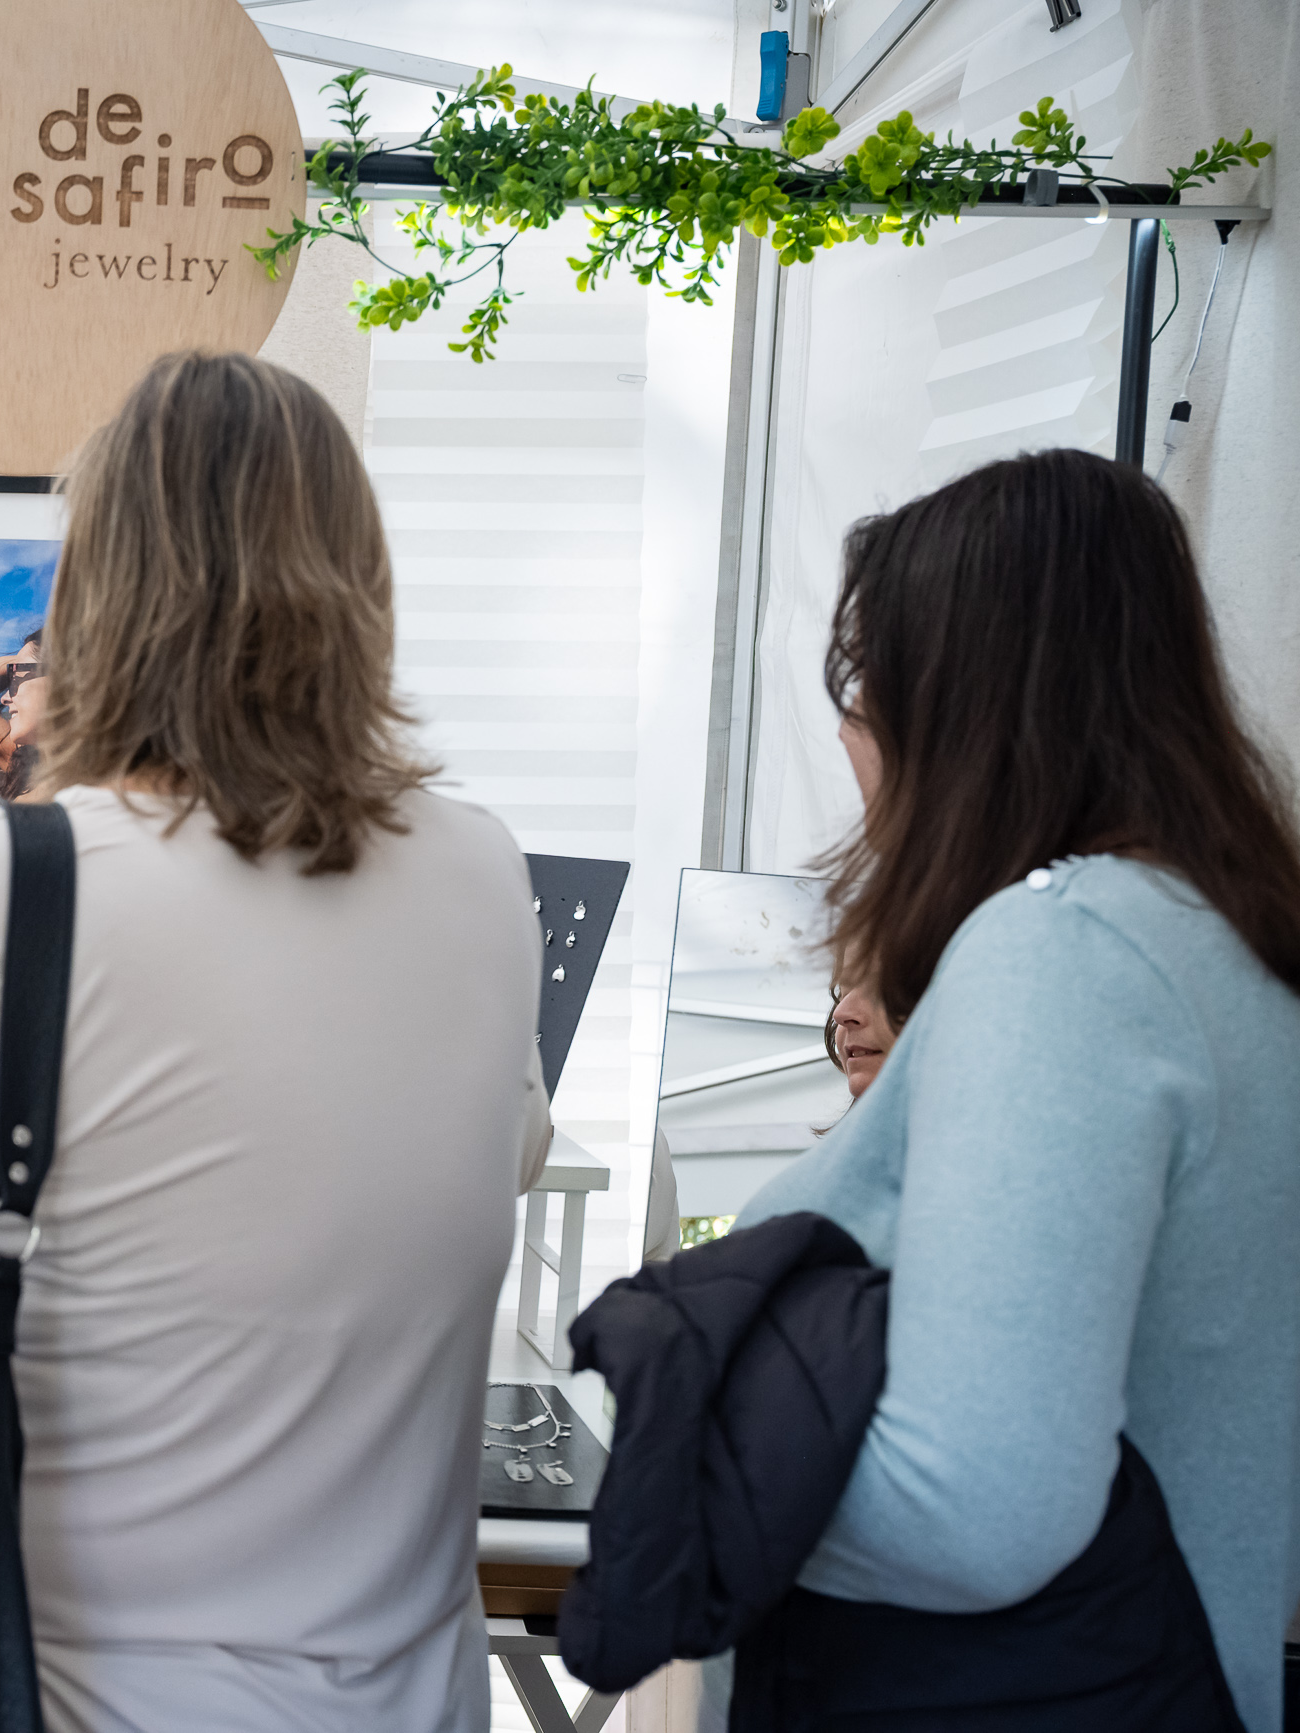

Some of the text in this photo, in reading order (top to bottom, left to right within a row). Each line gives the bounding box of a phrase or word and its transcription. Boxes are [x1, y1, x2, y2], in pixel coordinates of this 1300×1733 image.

[38, 88, 142, 161] de
[10, 133, 273, 228] safiro
[43, 238, 229, 295] jewelry
